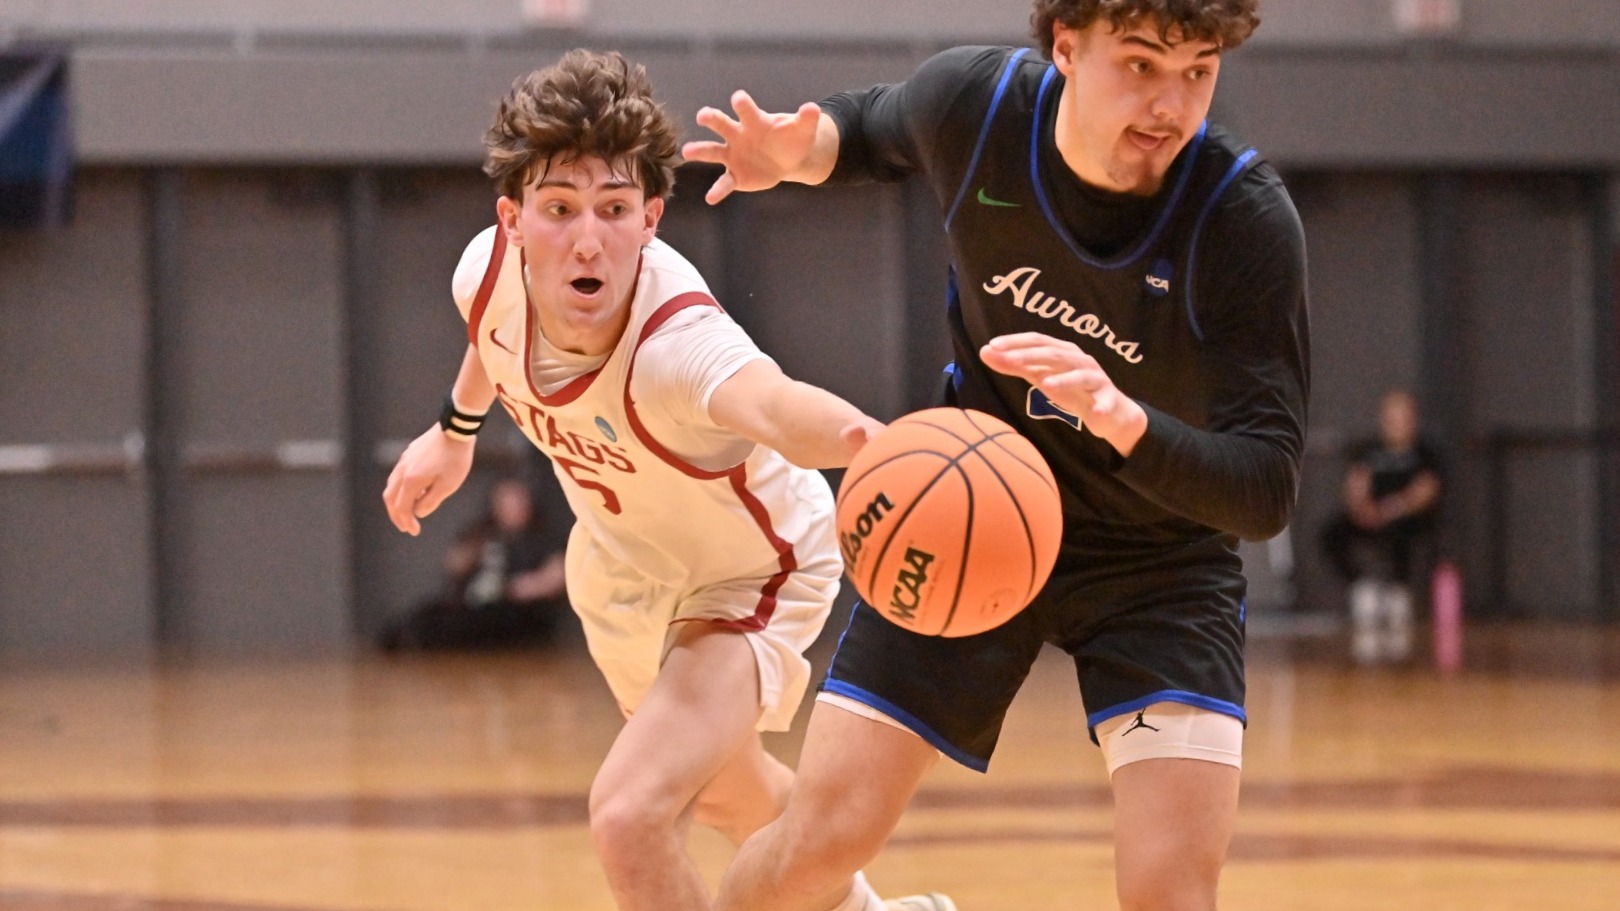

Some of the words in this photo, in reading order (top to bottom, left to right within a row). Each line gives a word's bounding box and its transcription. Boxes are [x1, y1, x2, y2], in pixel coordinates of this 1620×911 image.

[983, 266, 1144, 364] Aurora
[495, 383, 637, 474] STAGS
[551, 454, 622, 515] 5
[888, 546, 935, 625] NCAA
